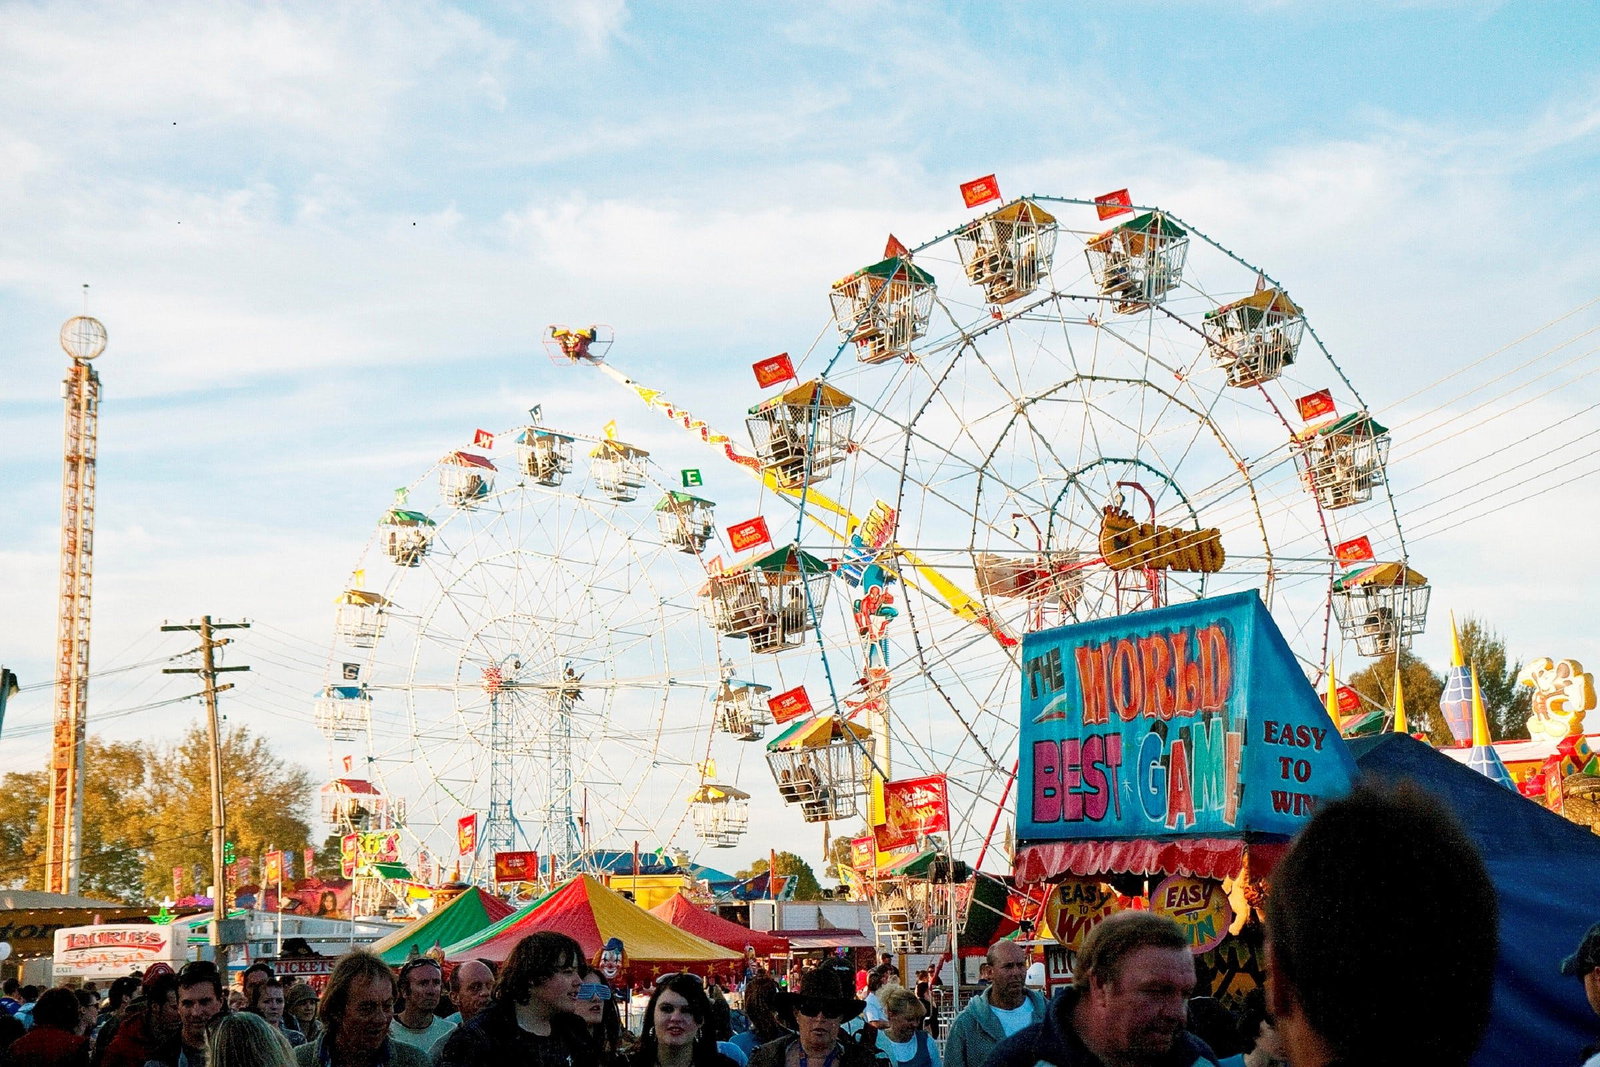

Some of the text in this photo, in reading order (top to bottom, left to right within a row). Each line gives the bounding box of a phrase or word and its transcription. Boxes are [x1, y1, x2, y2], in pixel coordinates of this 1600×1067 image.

[687, 471, 700, 486] E
[1024, 624, 1233, 726] THE WORLD
[1264, 720, 1327, 752] EASY
[1032, 717, 1244, 830] BEST GAME
[1279, 756, 1312, 783] TO
[1060, 884, 1112, 911] EASY
[1079, 904, 1088, 914] TO
[1165, 883, 1215, 916] EASY
[1184, 914, 1217, 945] IN
[1186, 912, 1199, 921] TO
[63, 931, 161, 948] LAURIE'S
[275, 961, 336, 974] TICKETS
